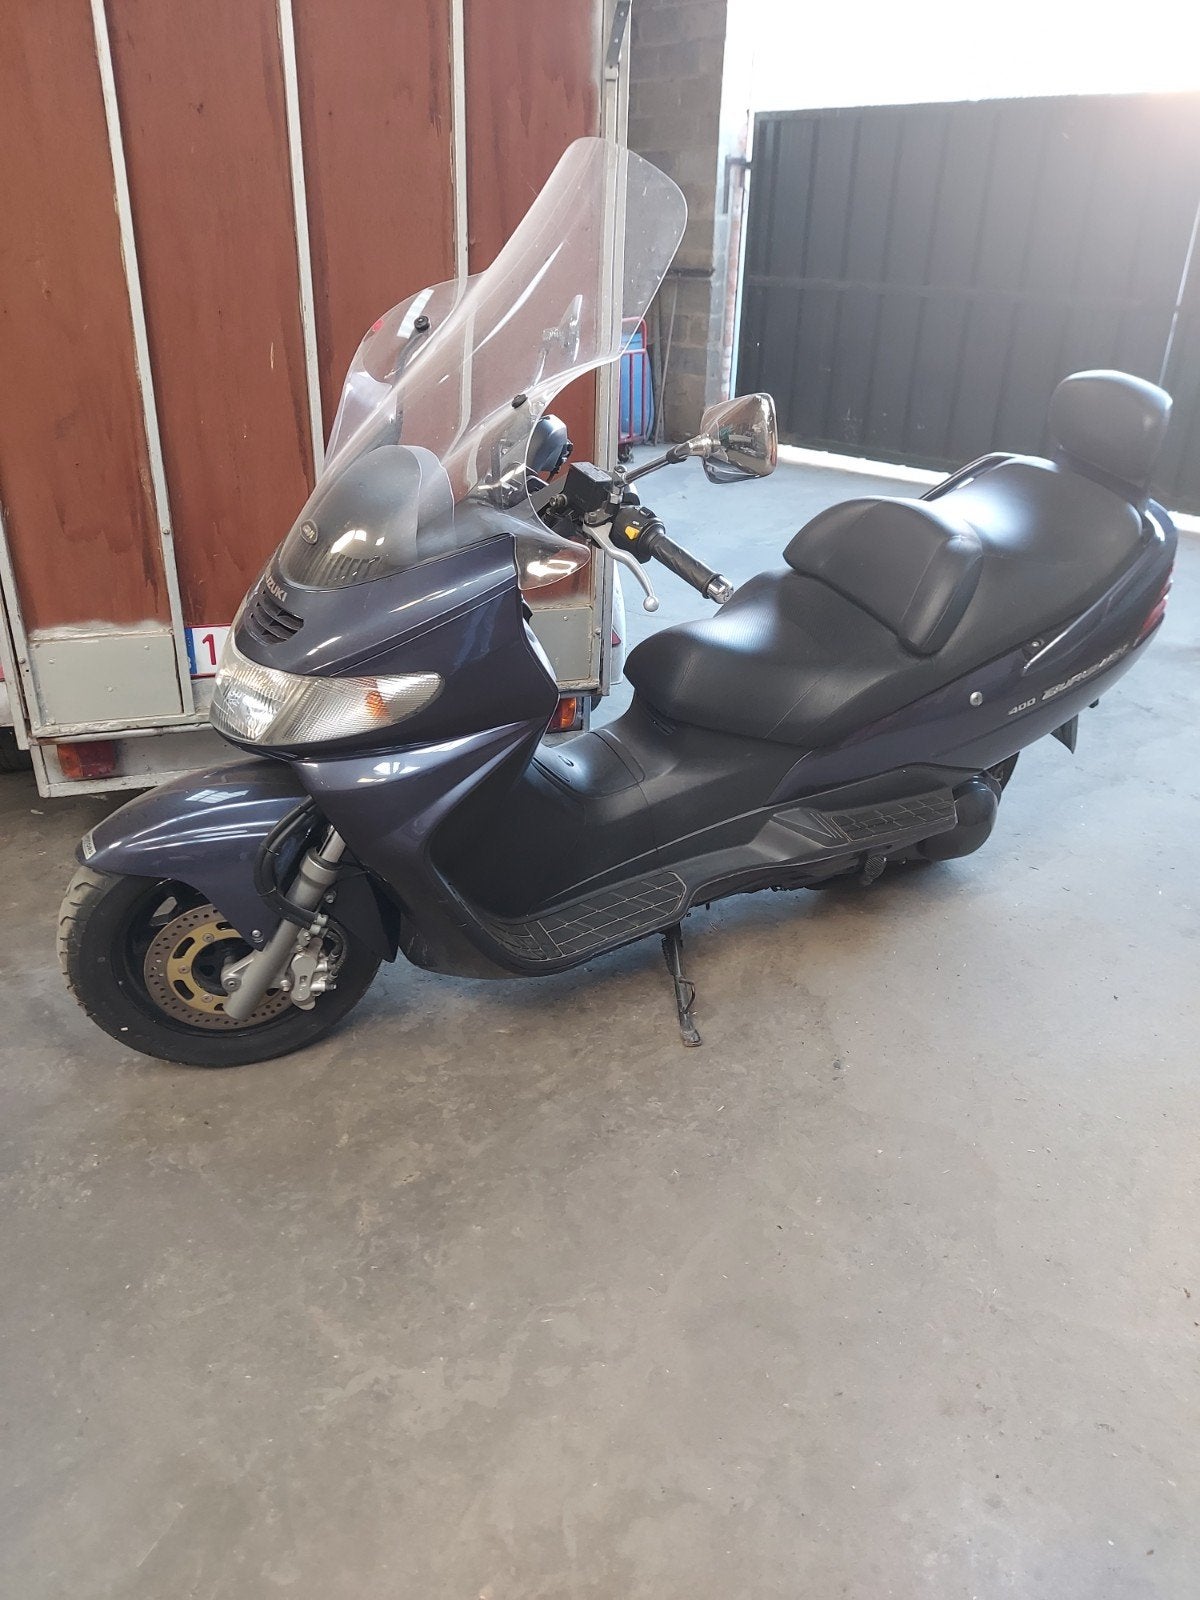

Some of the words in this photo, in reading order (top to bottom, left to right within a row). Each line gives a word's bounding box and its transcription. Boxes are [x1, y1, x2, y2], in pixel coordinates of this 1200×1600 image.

[265, 574, 288, 602] UZUKI
[202, 634, 217, 665] 1
[1007, 697, 1036, 716] 400
